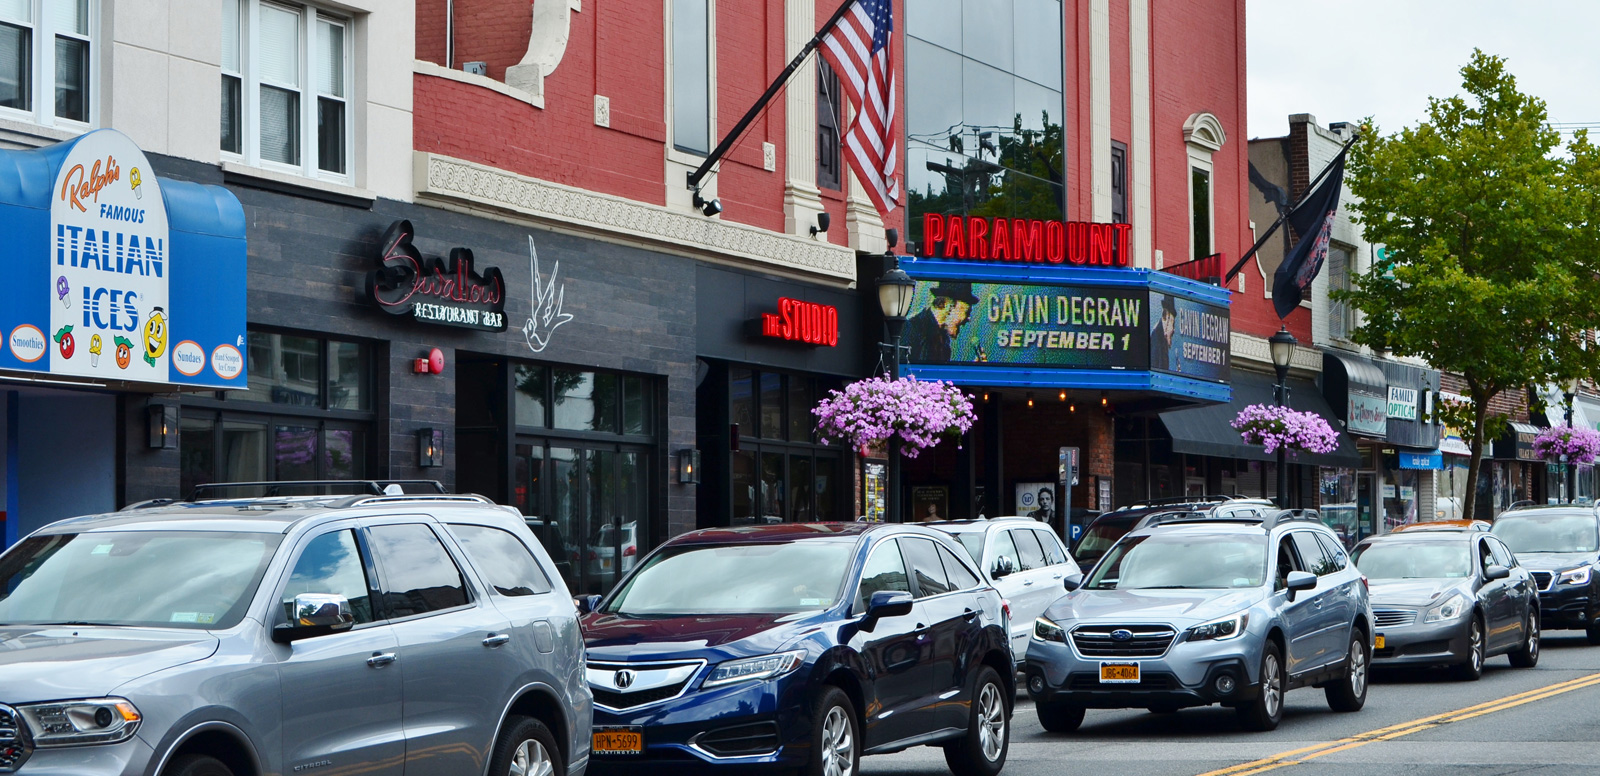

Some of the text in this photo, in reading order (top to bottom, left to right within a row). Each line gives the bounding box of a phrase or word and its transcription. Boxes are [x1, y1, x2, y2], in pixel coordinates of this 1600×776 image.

[61, 155, 119, 213] Ralph's
[100, 203, 145, 224] FAMOUS
[57, 223, 163, 278] ITALIAN
[923, 212, 1132, 266] PARAMOUNT
[83, 286, 138, 333] ICES
[414, 302, 480, 325] RESTAURANT
[987, 294, 1141, 327] GAVIN DEGRAW
[765, 297, 838, 347] THE STUDIO
[1179, 308, 1229, 344] GAVIN DEGRAW
[12, 334, 44, 350] Smoothies
[998, 329, 1130, 351] SEPTEMBER 1
[177, 350, 202, 364] Sundaes
[1183, 341, 1221, 365] SEPTEMBER
[1391, 387, 1415, 403] FAMILY
[1388, 402, 1415, 418] OPTICAL
